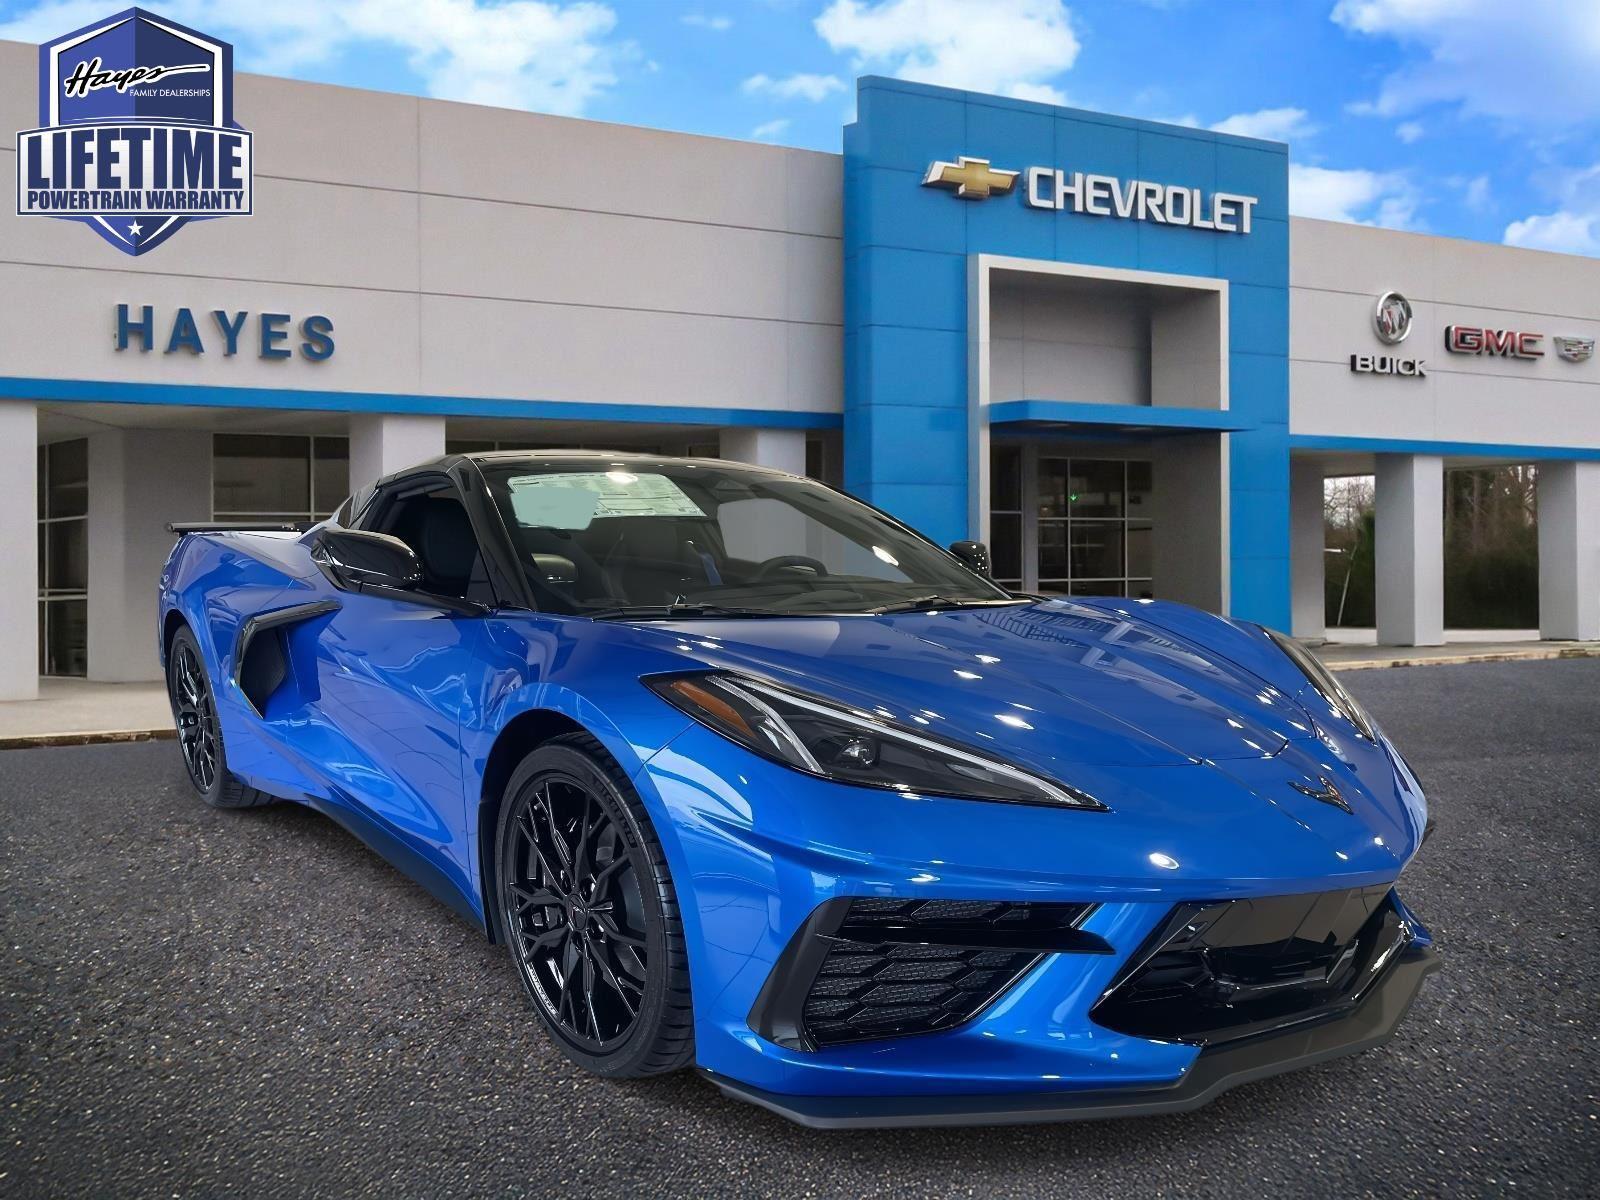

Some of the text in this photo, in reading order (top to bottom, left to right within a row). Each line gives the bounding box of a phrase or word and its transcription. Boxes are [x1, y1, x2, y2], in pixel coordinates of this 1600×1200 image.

[1026, 166, 1258, 234] CHEVROLET
[115, 304, 335, 361] HAYES
[1446, 325, 1545, 361] GMC
[1351, 354, 1426, 378] BUICK
